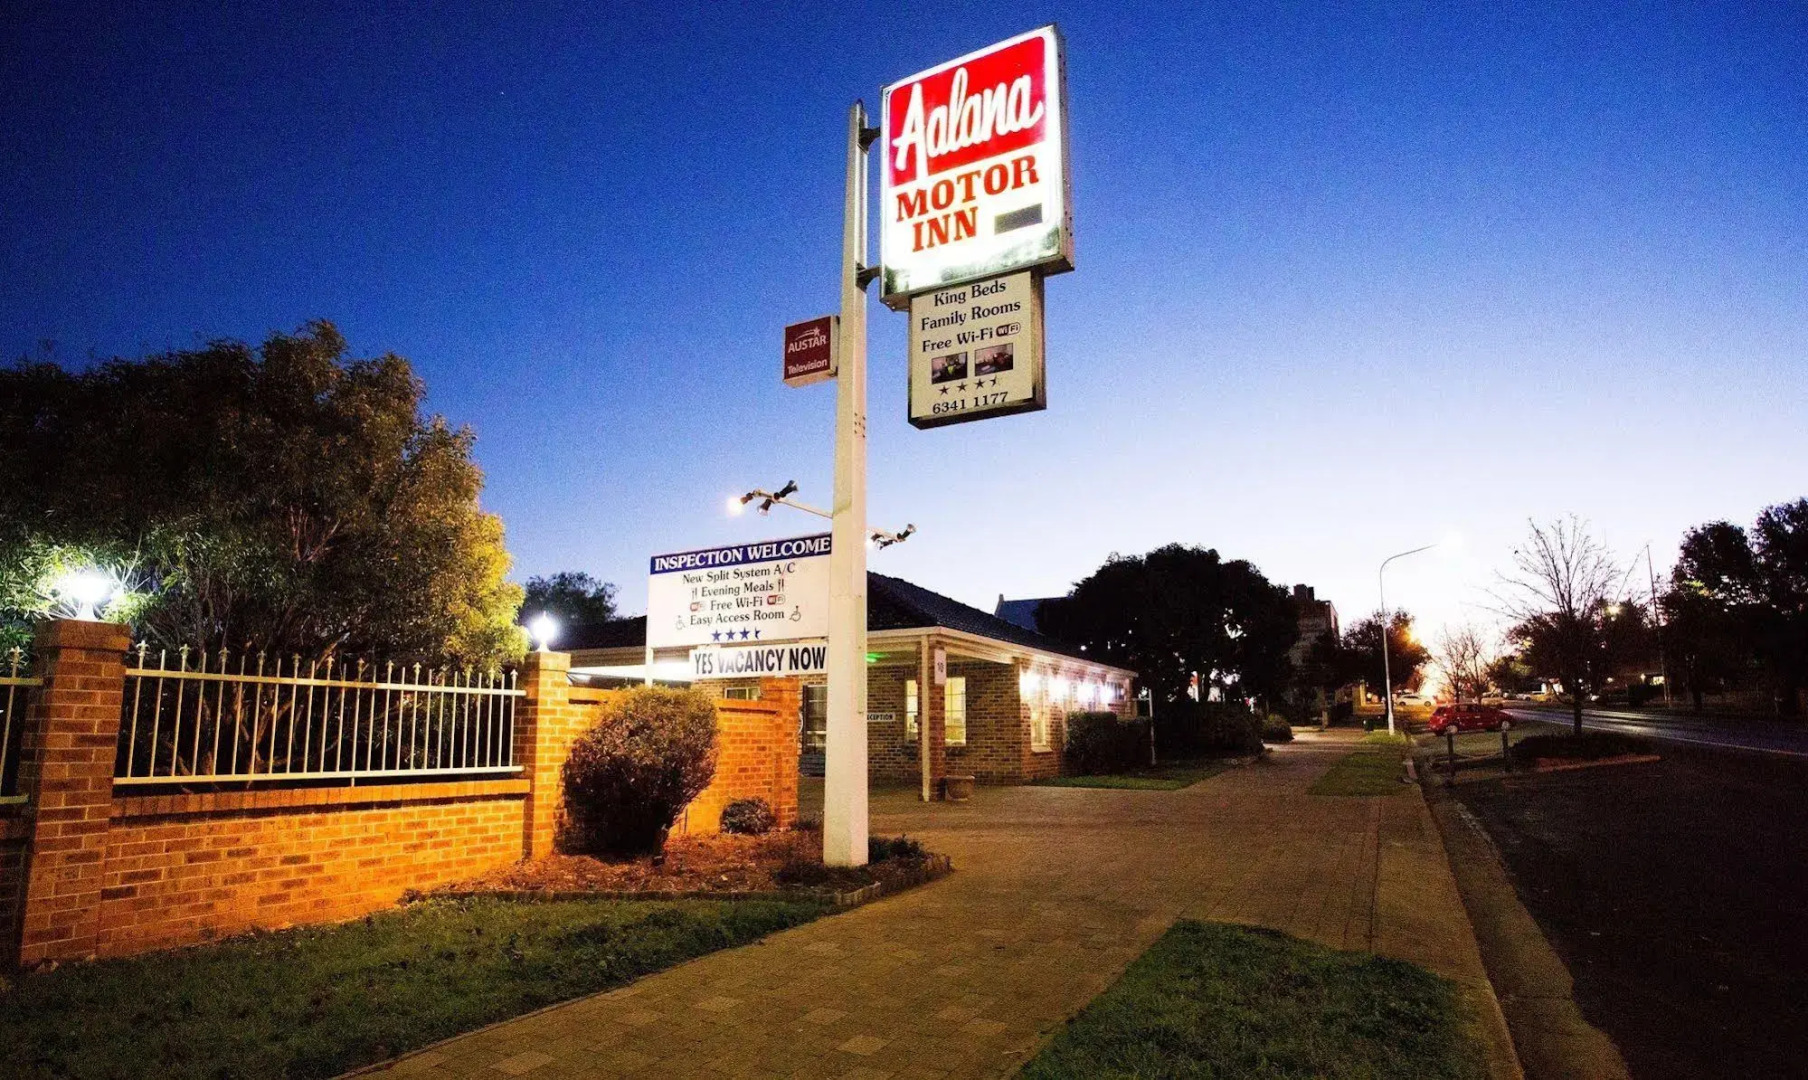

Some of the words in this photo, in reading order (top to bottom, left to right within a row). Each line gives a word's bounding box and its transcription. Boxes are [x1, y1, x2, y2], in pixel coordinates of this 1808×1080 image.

[892, 67, 1044, 181] Aalana
[896, 154, 1039, 223] MOTOR
[912, 207, 978, 253] INN
[934, 292, 966, 307] King
[971, 280, 1006, 299] Beds
[921, 310, 967, 331] Family
[971, 301, 1021, 320] Rooms
[787, 335, 827, 353] AUSTAR
[922, 339, 952, 352] Free
[956, 327, 993, 345] Wi-Fi
[787, 359, 828, 375] Television
[932, 399, 967, 414] 6341
[974, 391, 1009, 407] 1177
[654, 548, 743, 571] INSPECTION
[747, 537, 831, 562] WELCOME
[683, 573, 704, 584] New
[706, 569, 730, 584] Split
[733, 567, 771, 581] System
[773, 562, 796, 576] A/C
[701, 584, 740, 597] Evening
[743, 579, 775, 593] Meals
[710, 599, 733, 611] Free
[735, 596, 763, 608] Wi-Fi
[690, 614, 713, 627] Easy
[716, 612, 750, 624] Access
[753, 609, 785, 621] Room
[694, 652, 713, 674] YES
[718, 648, 785, 674] VACANCY
[788, 646, 826, 671] NOW
